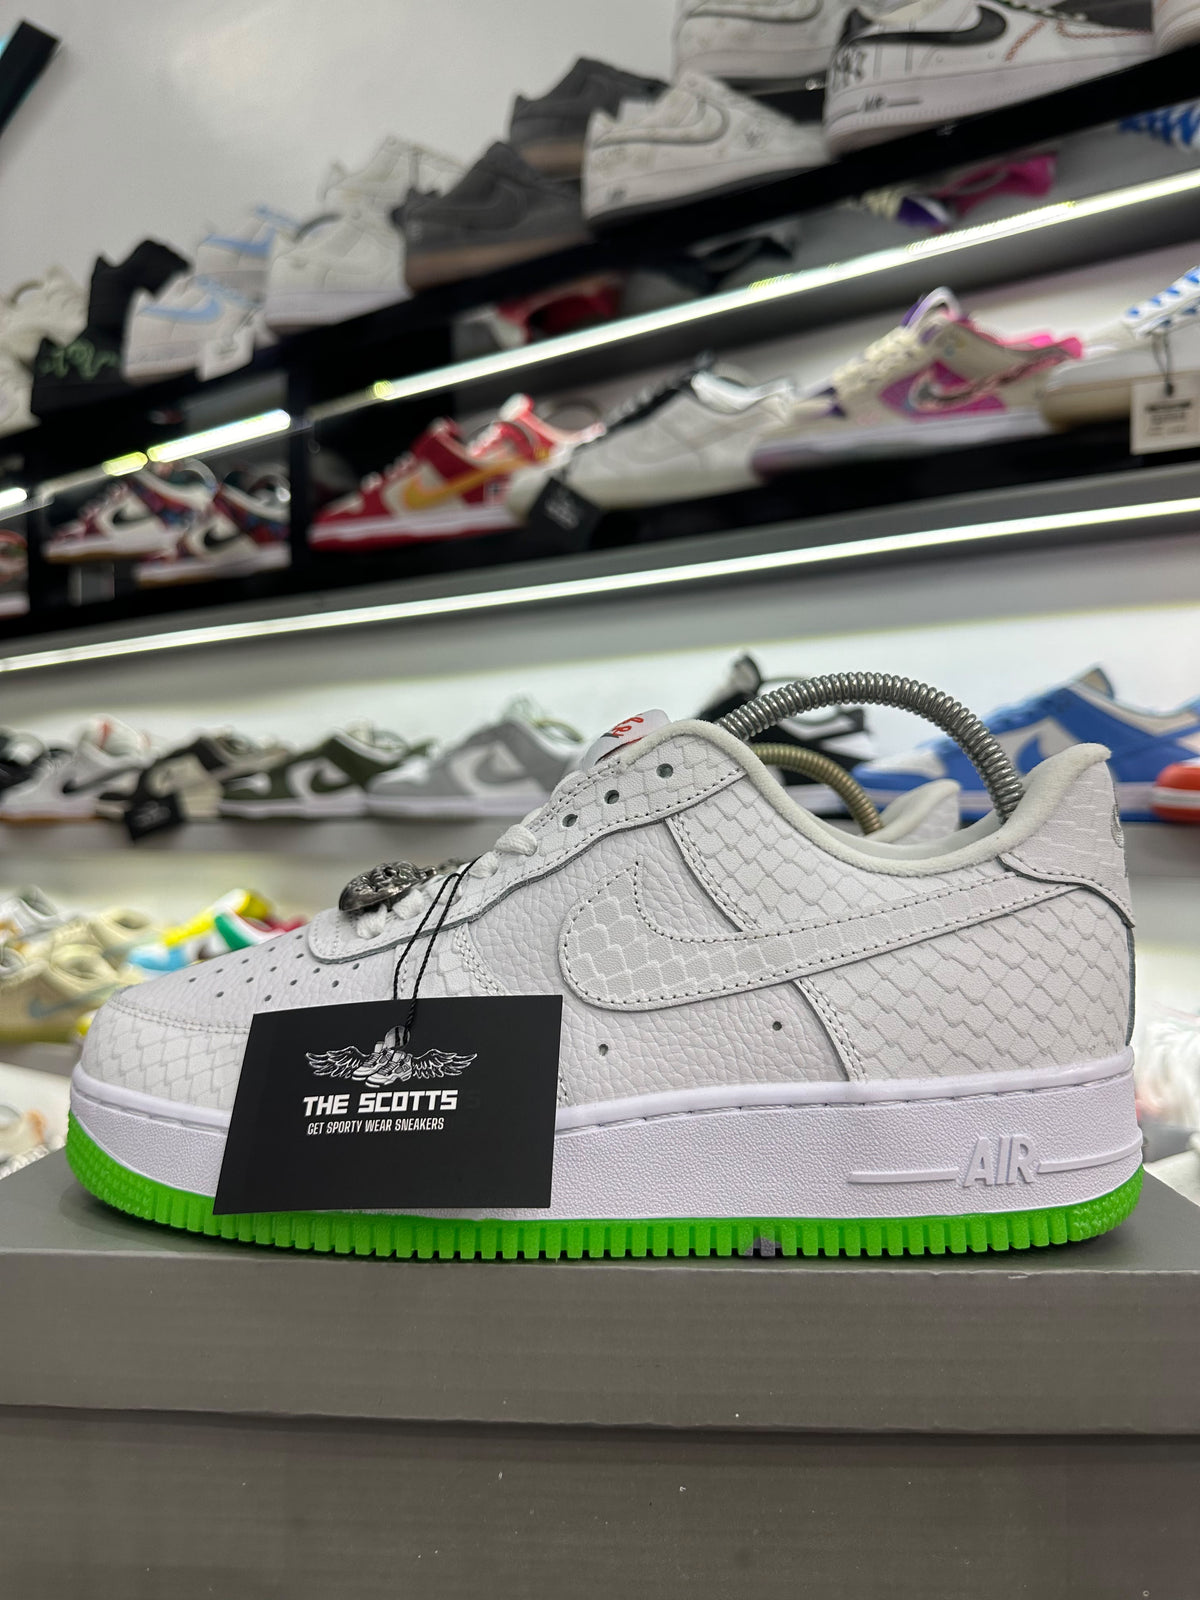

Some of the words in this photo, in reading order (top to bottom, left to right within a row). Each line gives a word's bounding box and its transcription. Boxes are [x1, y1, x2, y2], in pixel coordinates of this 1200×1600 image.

[302, 1093, 351, 1118] THE
[357, 1089, 459, 1114] SCOTTS
[307, 1120, 325, 1136] GET
[326, 1119, 363, 1135] SPORTY
[364, 1118, 392, 1133] WEAR
[394, 1117, 445, 1132] SNEAKERS
[962, 1134, 1036, 1188] AIR
